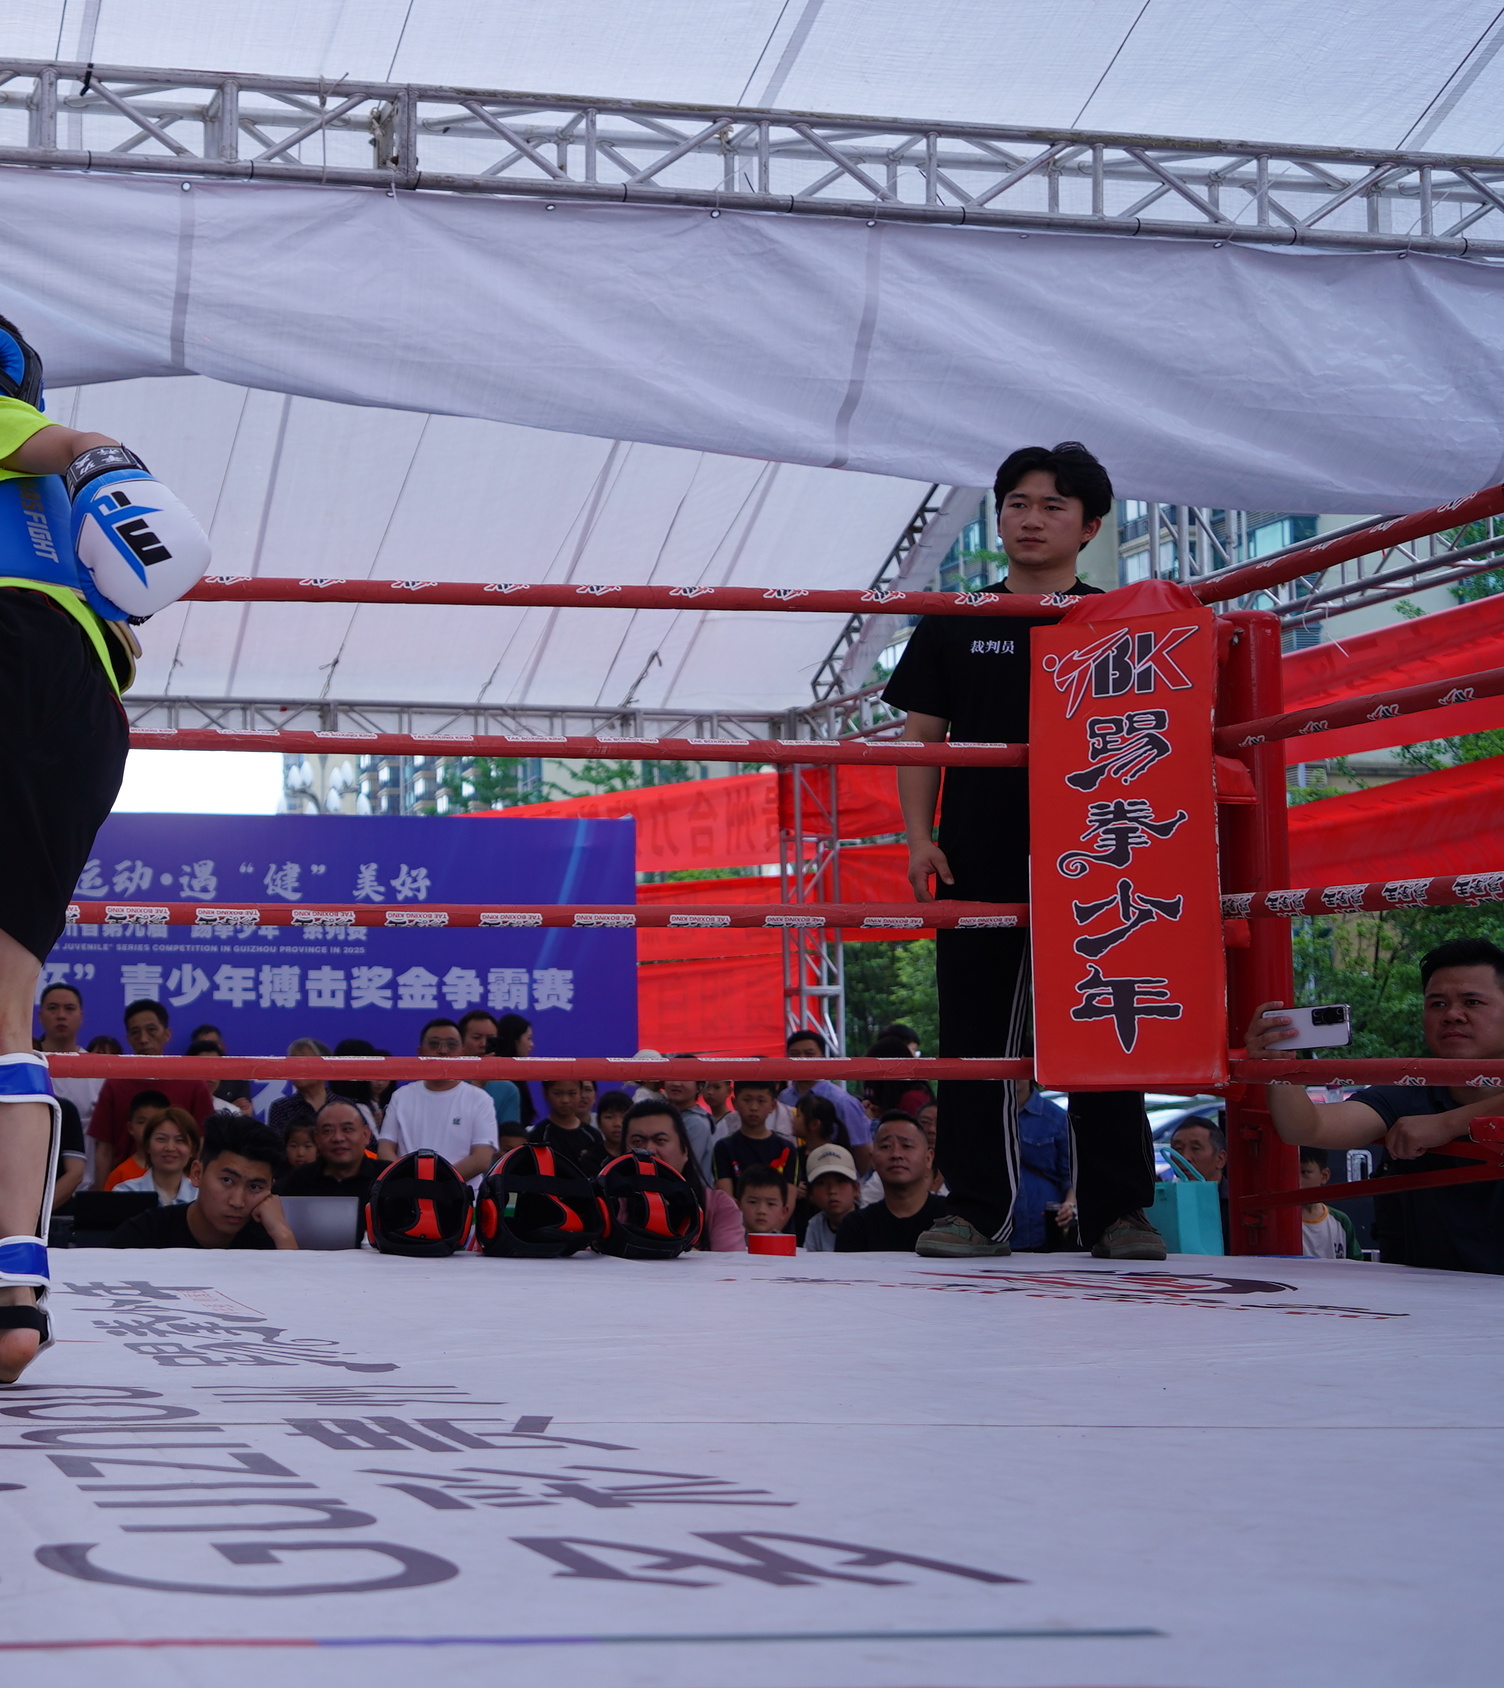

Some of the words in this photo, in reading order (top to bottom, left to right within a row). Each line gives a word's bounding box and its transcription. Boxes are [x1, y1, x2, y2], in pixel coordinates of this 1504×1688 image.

[970, 639, 1015, 655] 裁判员
[1056, 707, 1188, 1055] 踢拳少年
[116, 943, 150, 951] SERIES
[152, 944, 218, 952] COMPETITION
[233, 945, 276, 953] GUIZHOU
[330, 946, 340, 954] IN
[343, 946, 365, 954] 2025
[119, 962, 575, 1012] 青少年搏击奖金争霸赛
[191, 1385, 1032, 1586] 多彩贵州
